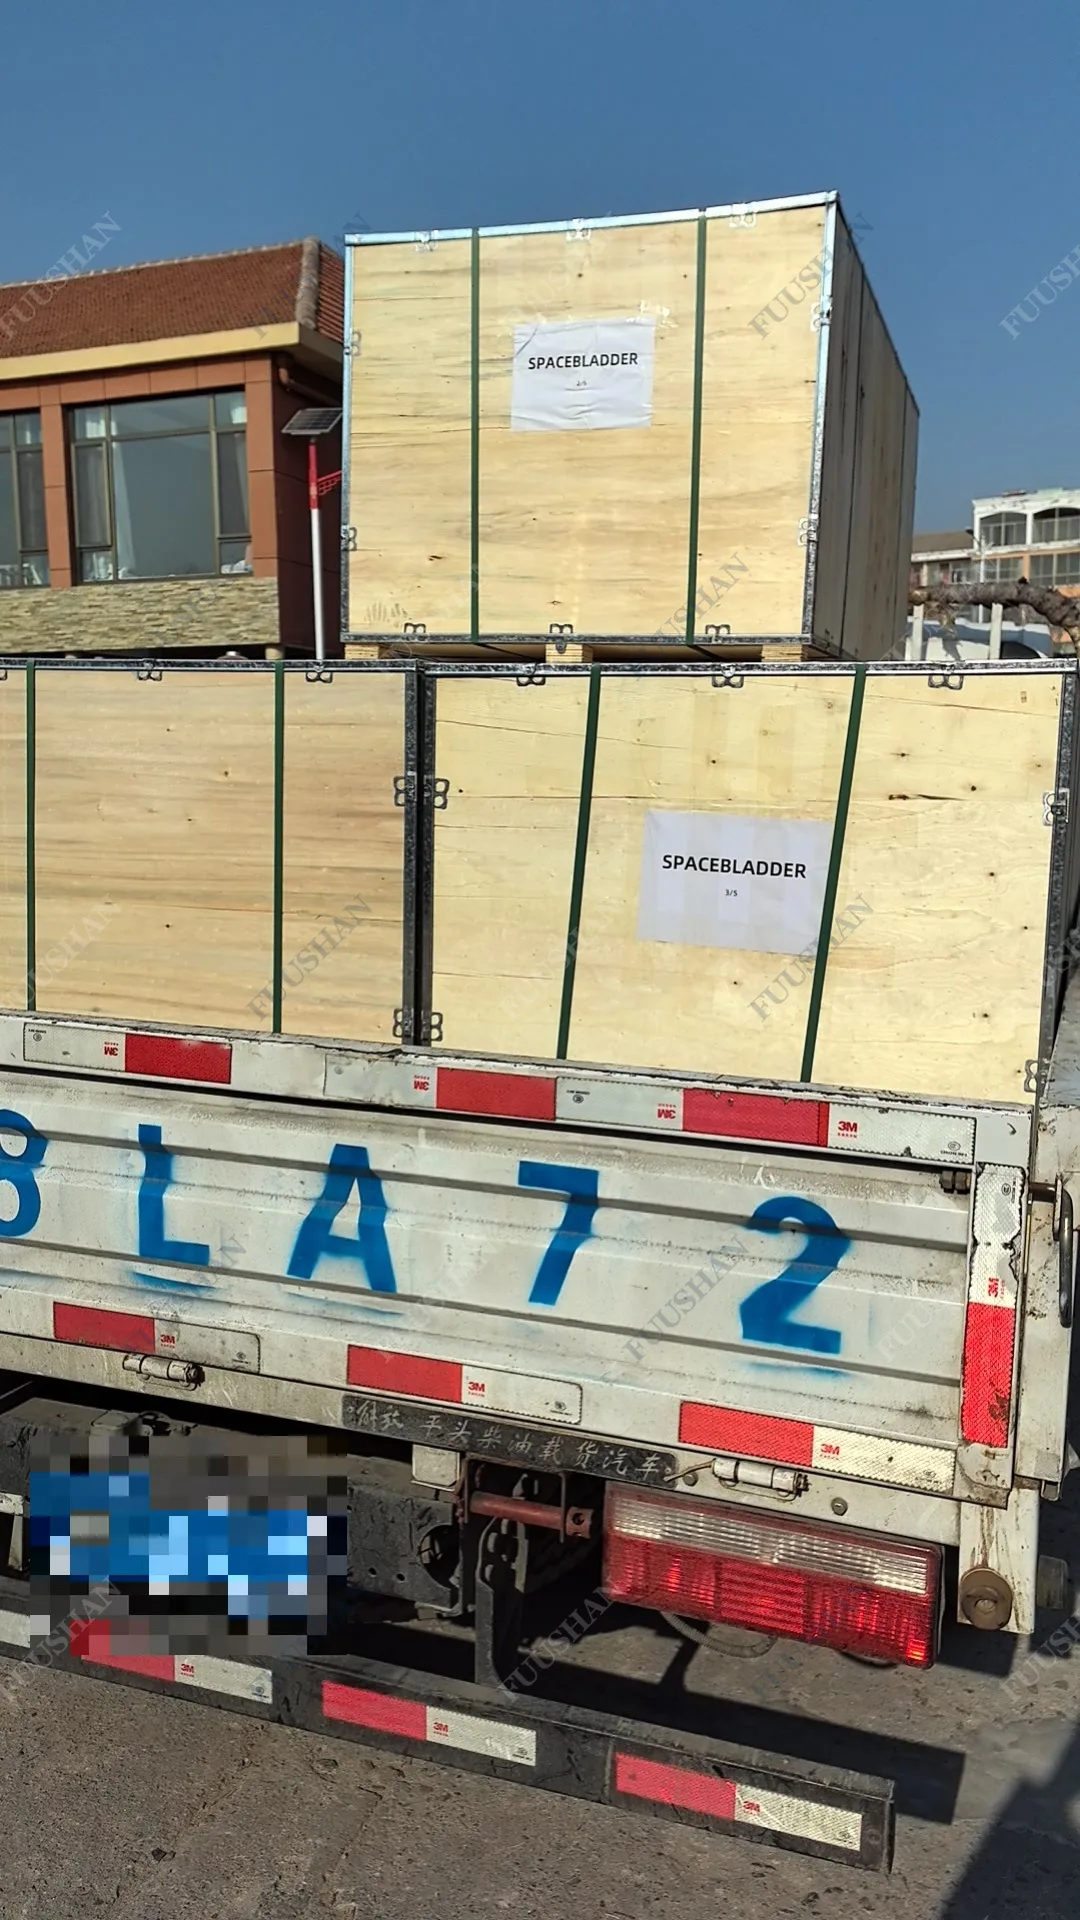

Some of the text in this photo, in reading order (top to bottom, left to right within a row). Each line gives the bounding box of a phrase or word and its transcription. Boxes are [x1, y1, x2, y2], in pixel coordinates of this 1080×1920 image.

[528, 352, 638, 370] SPACEBLADDER
[662, 854, 806, 878] SPACEBLADDER
[725, 889, 738, 897] 3/5
[104, 1046, 118, 1056] 3M
[413, 1080, 429, 1091] 3M
[657, 1108, 676, 1119] 3M
[838, 1120, 858, 1132] 3M
[988, 1277, 999, 1297] 3M
[160, 1334, 175, 1344] 3M
[468, 1381, 485, 1392] 3M
[821, 1443, 840, 1455] 3M
[180, 1663, 194, 1673] 3M
[433, 1722, 449, 1732] 3M
